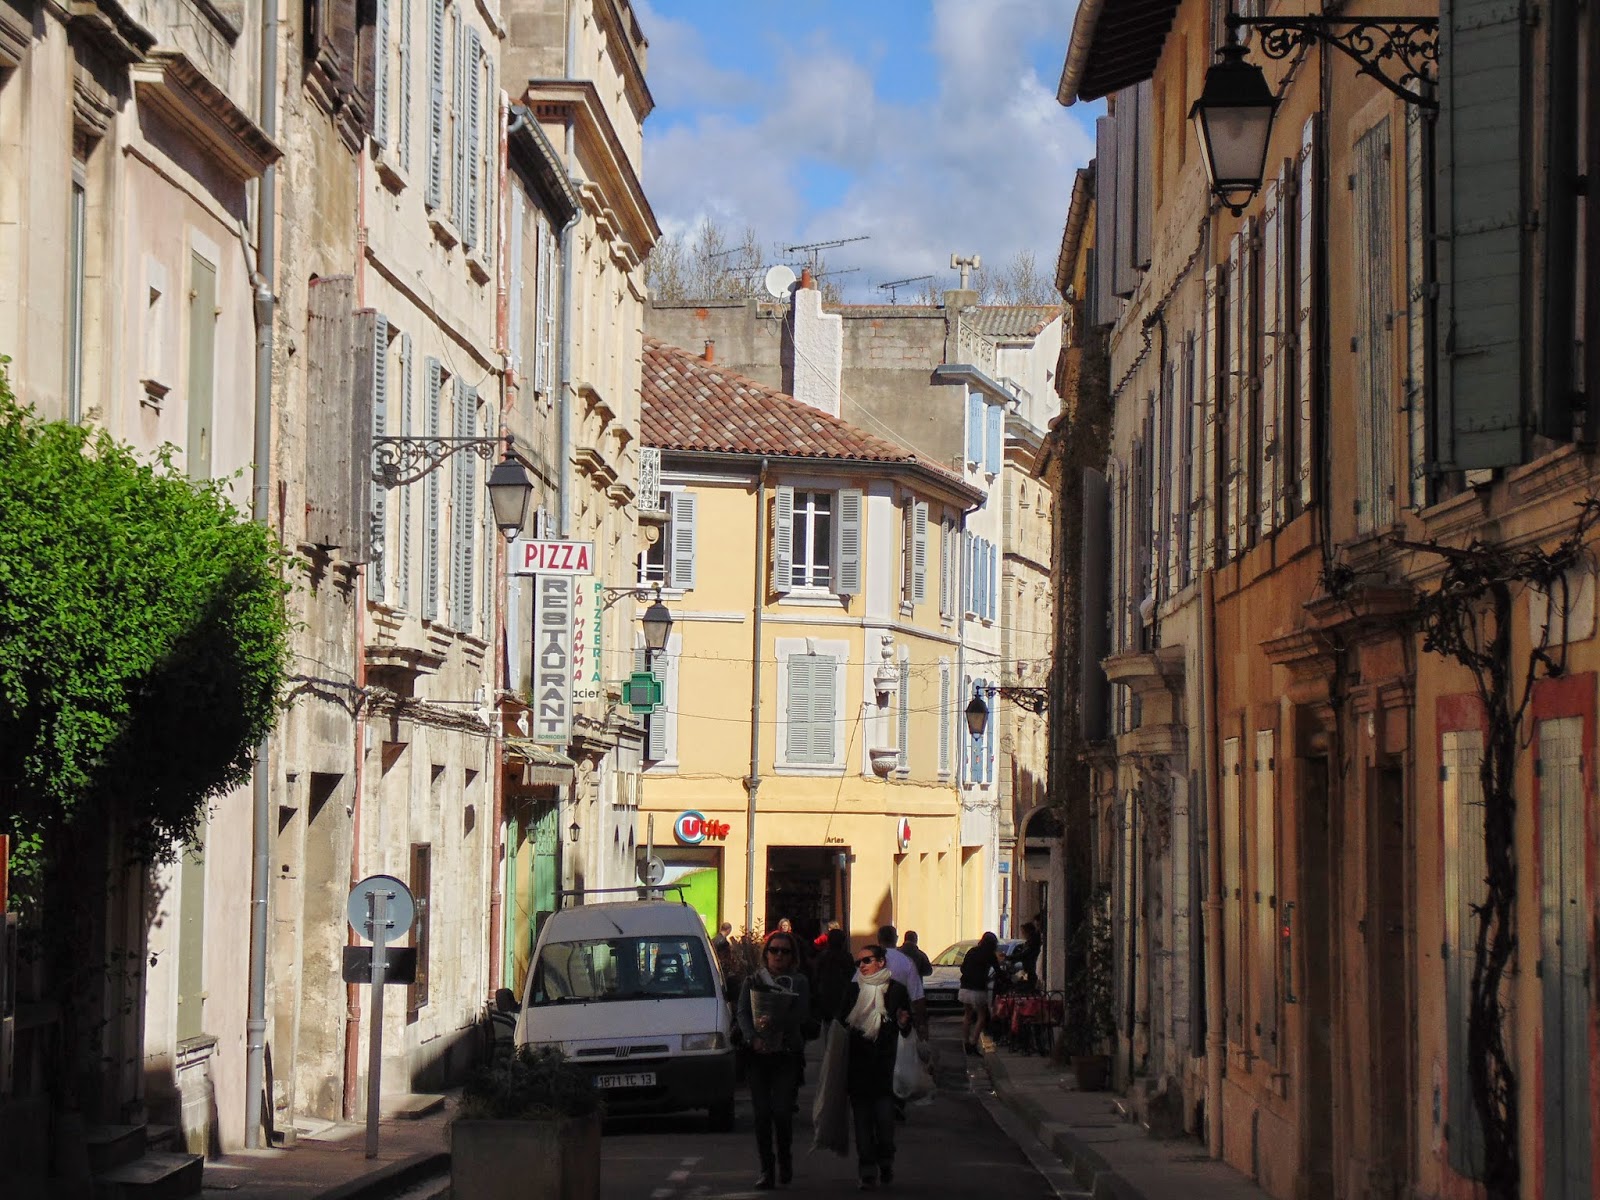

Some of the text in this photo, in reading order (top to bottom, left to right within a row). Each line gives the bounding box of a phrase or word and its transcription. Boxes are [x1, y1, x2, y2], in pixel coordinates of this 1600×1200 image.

[524, 543, 588, 570] PIZZA
[573, 583, 585, 681] LA MAMMA
[591, 583, 602, 682] PIZZERIA
[539, 578, 568, 732] RESTAURANT
[573, 688, 600, 698] acier
[682, 819, 731, 836] Utile
[599, 1074, 652, 1087] 1871 TC 13
